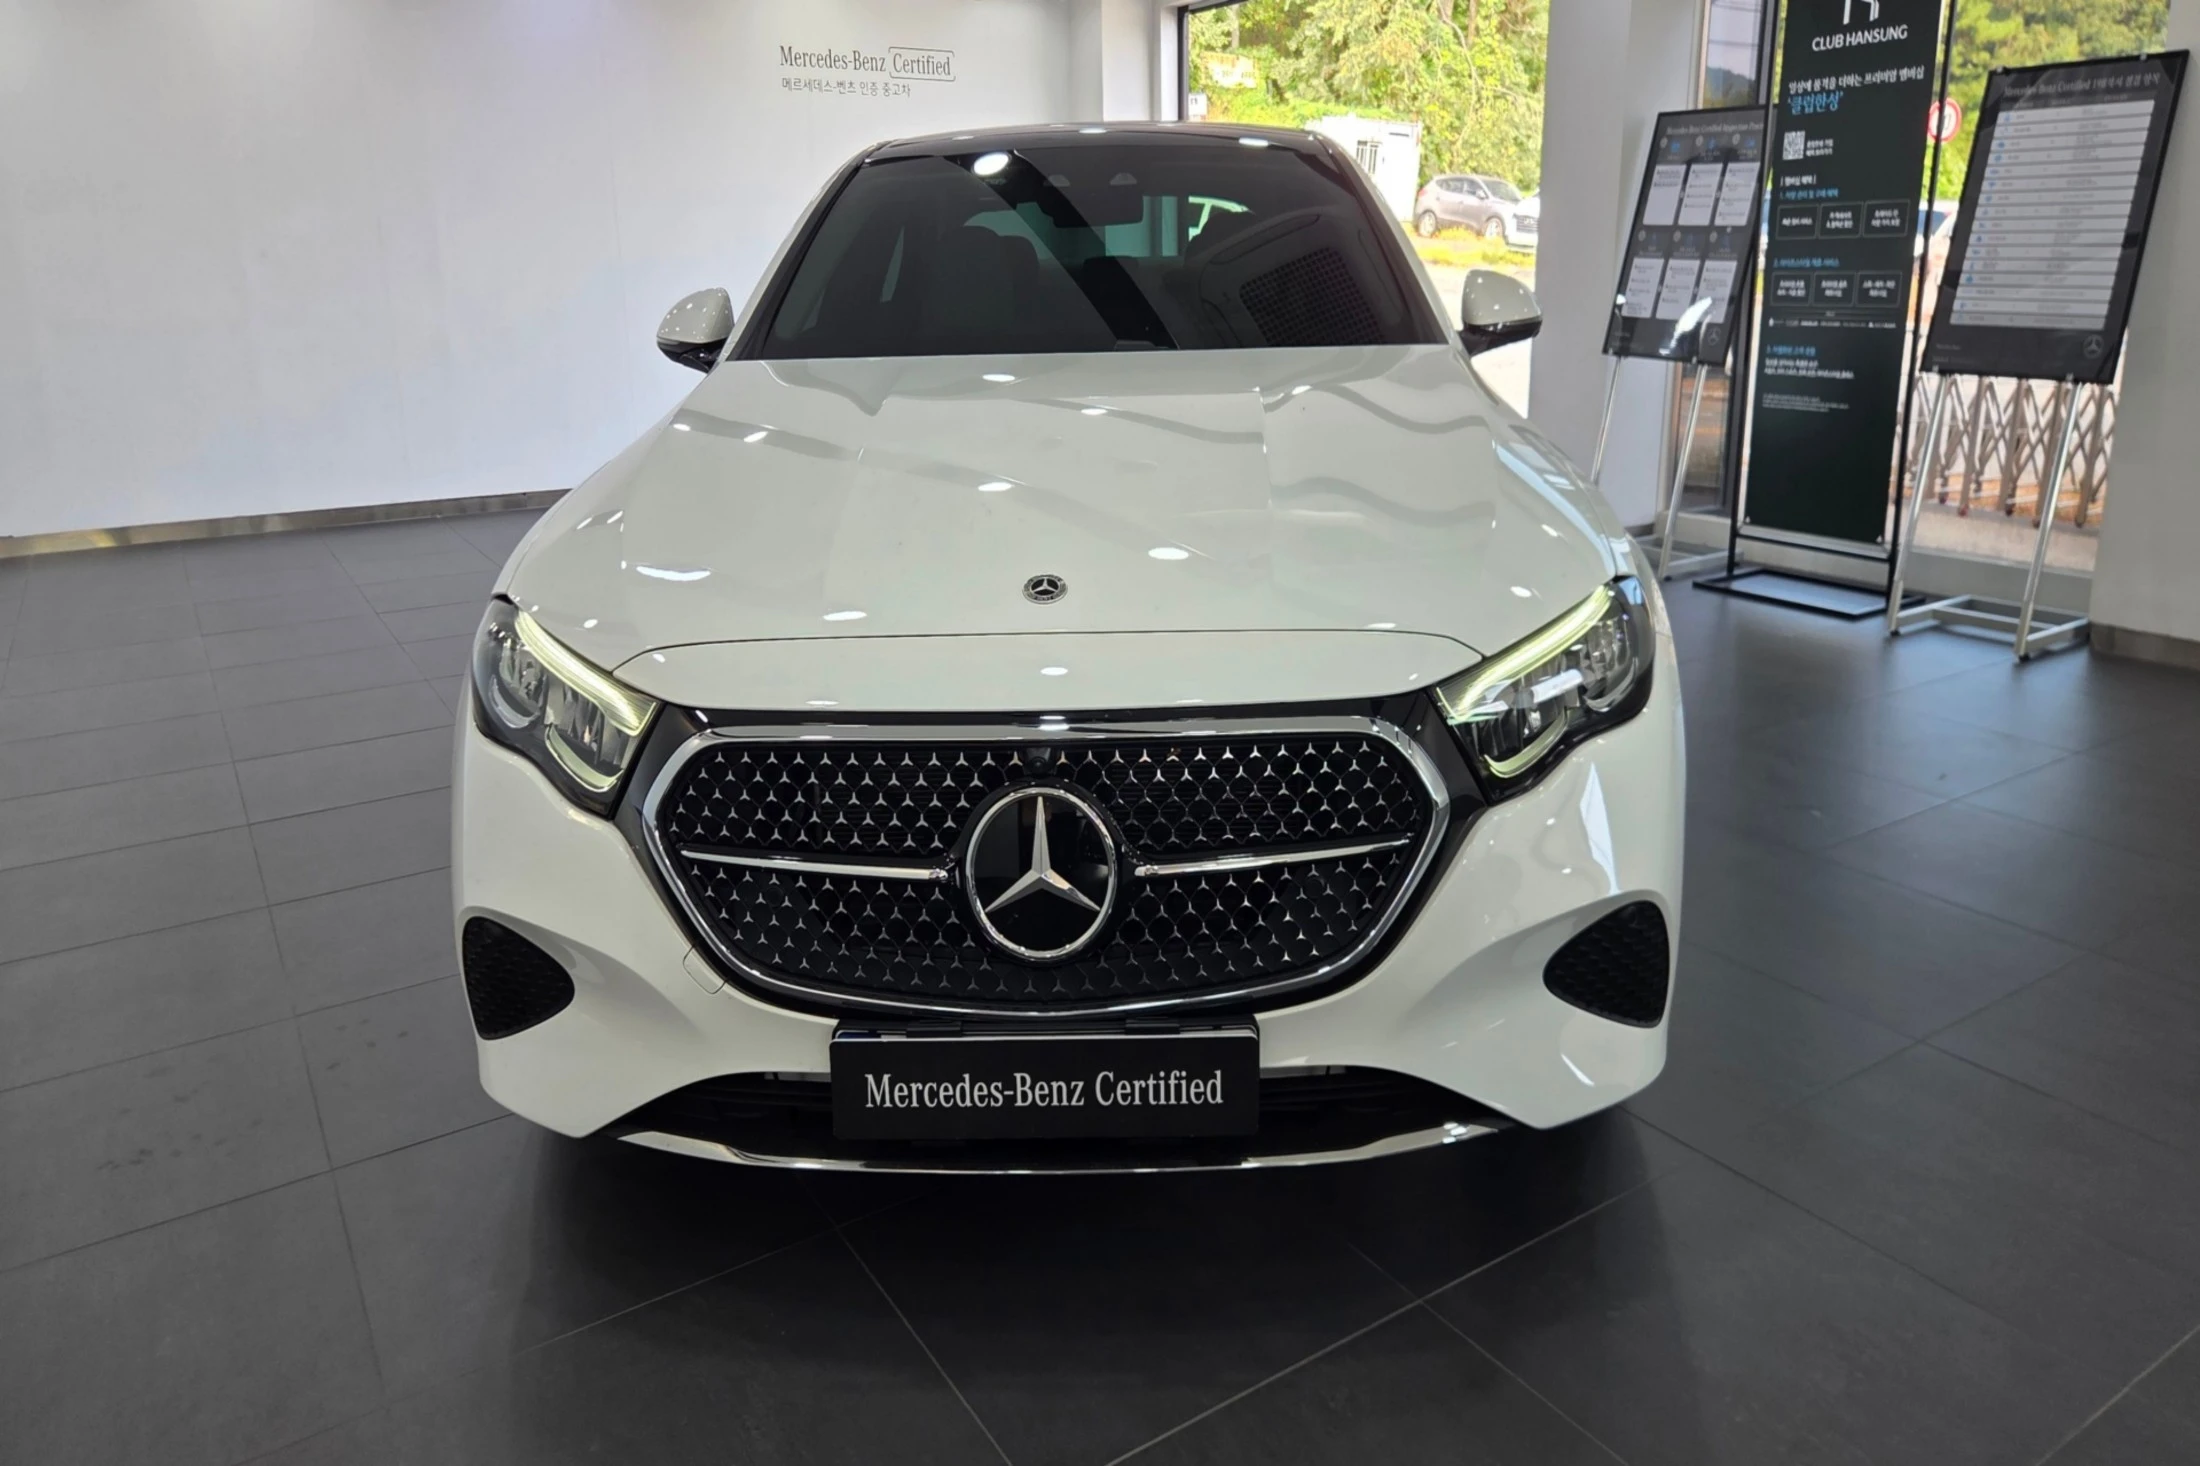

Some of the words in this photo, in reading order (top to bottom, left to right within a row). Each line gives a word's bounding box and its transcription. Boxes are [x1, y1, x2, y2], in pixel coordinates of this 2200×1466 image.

[1812, 33, 1844, 52] CLUB
[1846, 24, 1908, 47] HANSUNG
[780, 45, 886, 72] Mercedes-Benz
[893, 53, 951, 76] Certified
[782, 77, 856, 94] 메르세데스-벤츠
[860, 81, 879, 96] 인증
[882, 83, 911, 97] 중고차
[1864, 68, 1897, 84] 프리미엄
[864, 1072, 1085, 1108] Mercedes-Benz
[1094, 1069, 1224, 1107] Certified
